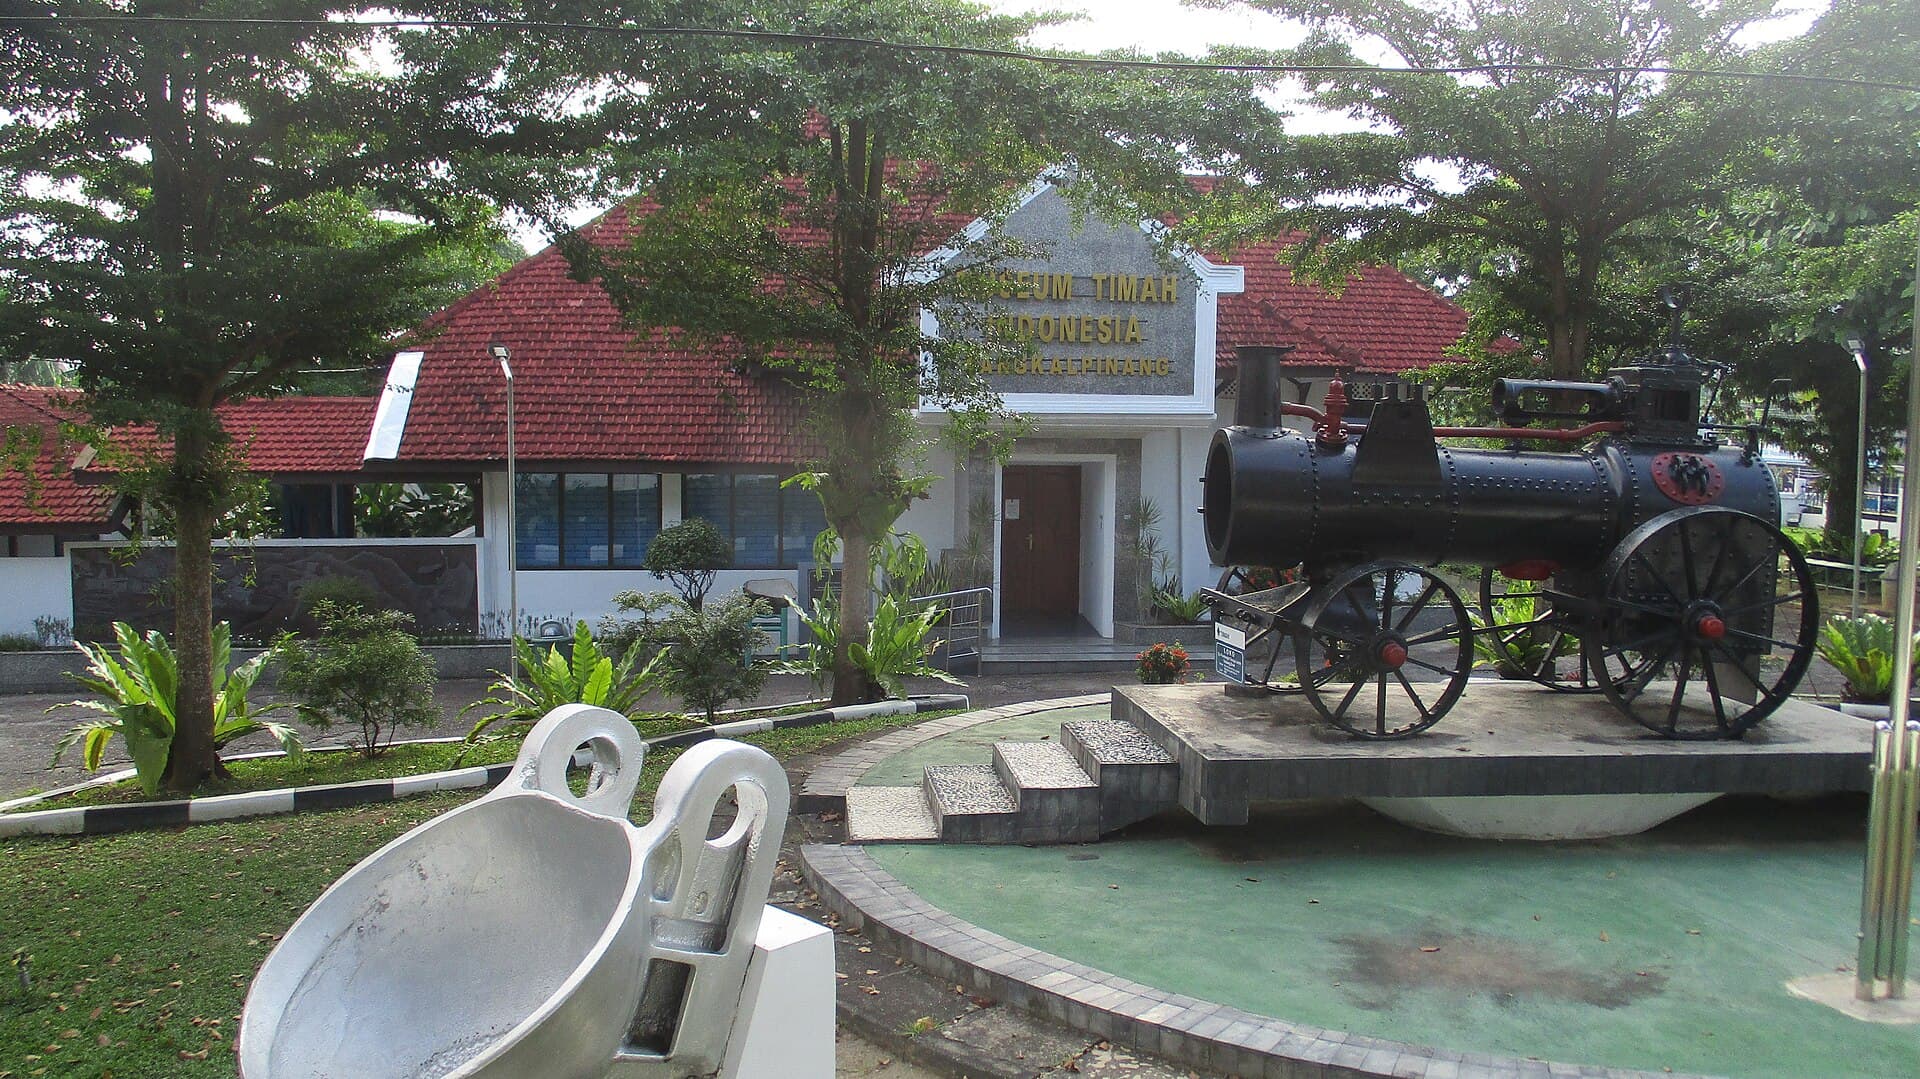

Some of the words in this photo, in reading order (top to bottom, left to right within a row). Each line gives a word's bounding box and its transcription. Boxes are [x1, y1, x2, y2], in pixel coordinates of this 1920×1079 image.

[956, 271, 1073, 300] SEUM
[1093, 274, 1178, 302] TIMAH
[967, 355, 1169, 375] ANGKALPINANG
